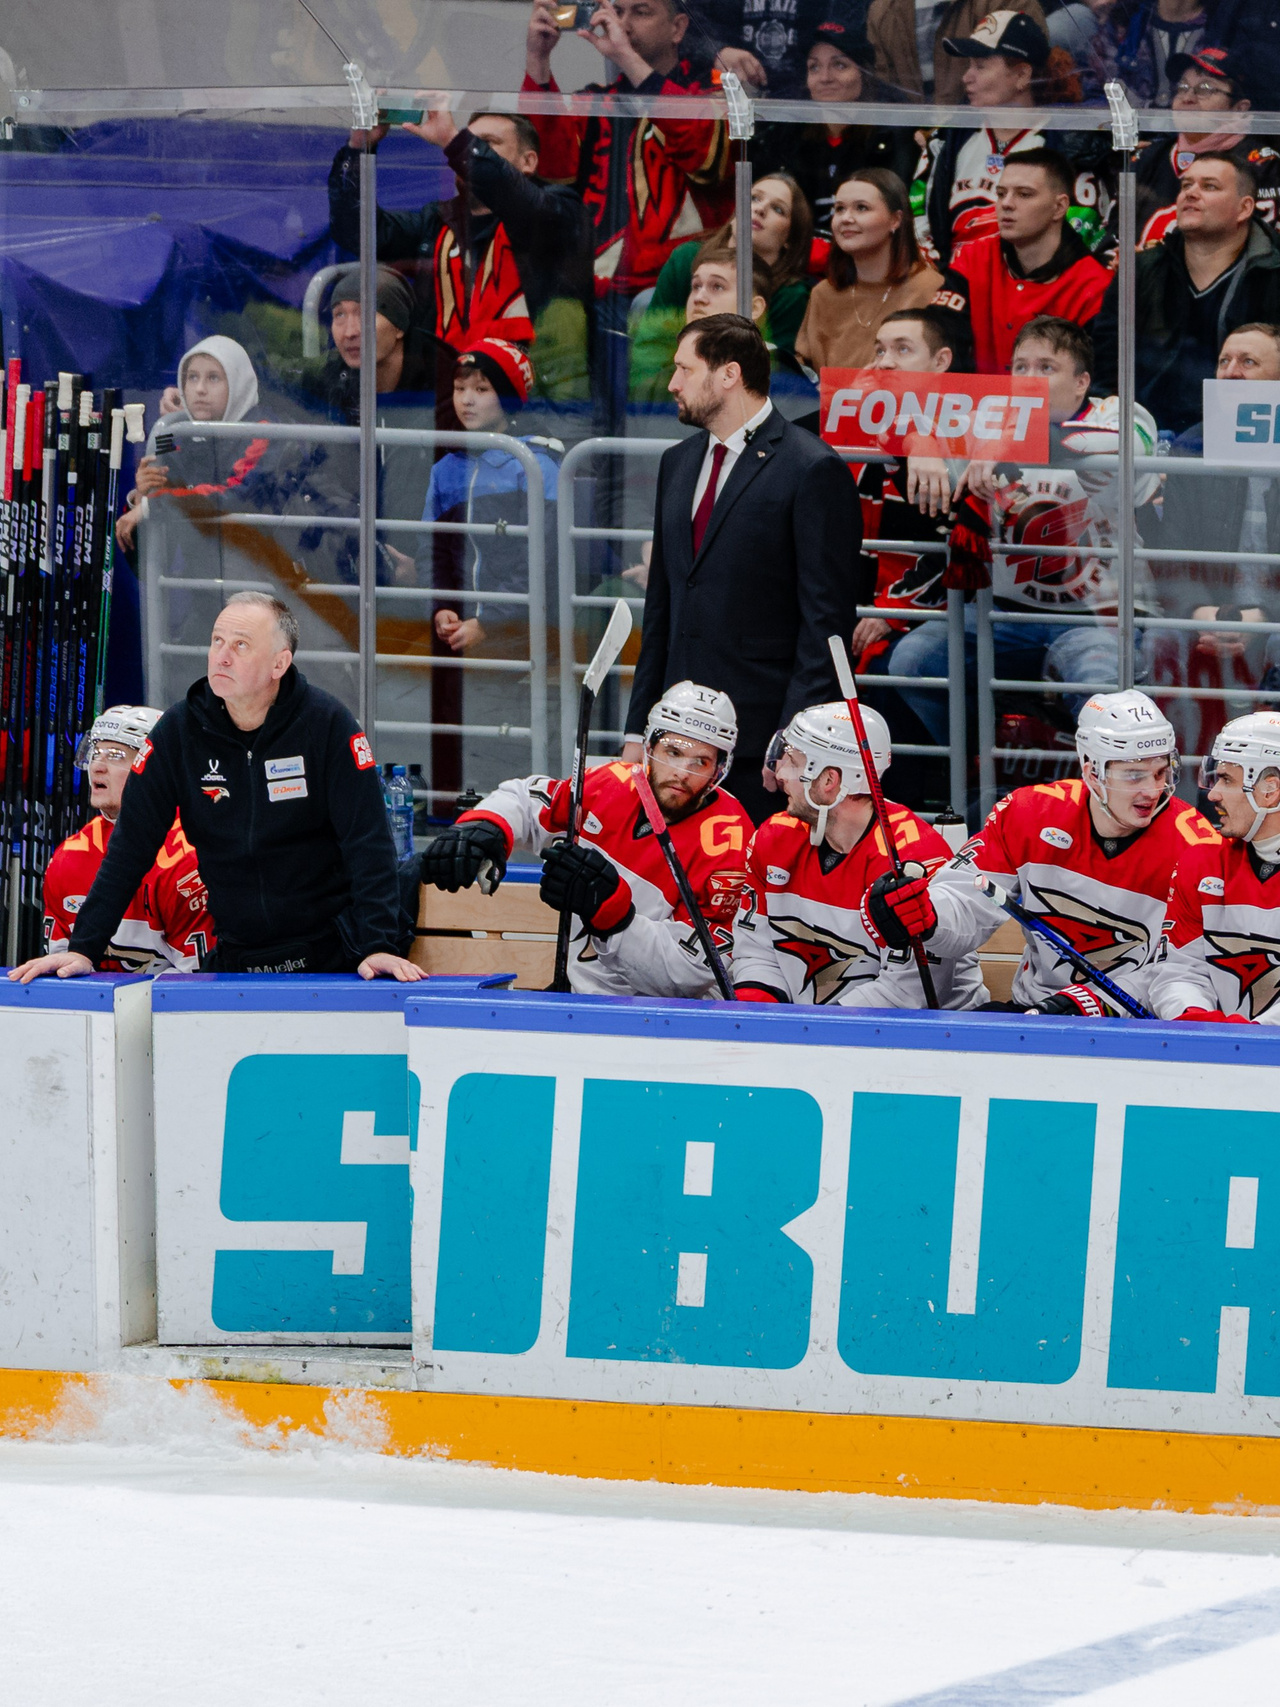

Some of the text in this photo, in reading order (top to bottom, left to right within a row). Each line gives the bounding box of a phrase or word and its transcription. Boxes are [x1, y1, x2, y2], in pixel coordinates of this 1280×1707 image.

[825, 388, 1044, 441] FONBET
[10, 500, 20, 562] CCM
[19, 503, 29, 564] CCM
[28, 499, 38, 561] CCM
[55, 503, 65, 566] CCM
[73, 505, 84, 567] CCM
[83, 503, 94, 565] CCM
[697, 690, 718, 705] 17
[1127, 706, 1153, 722] 74
